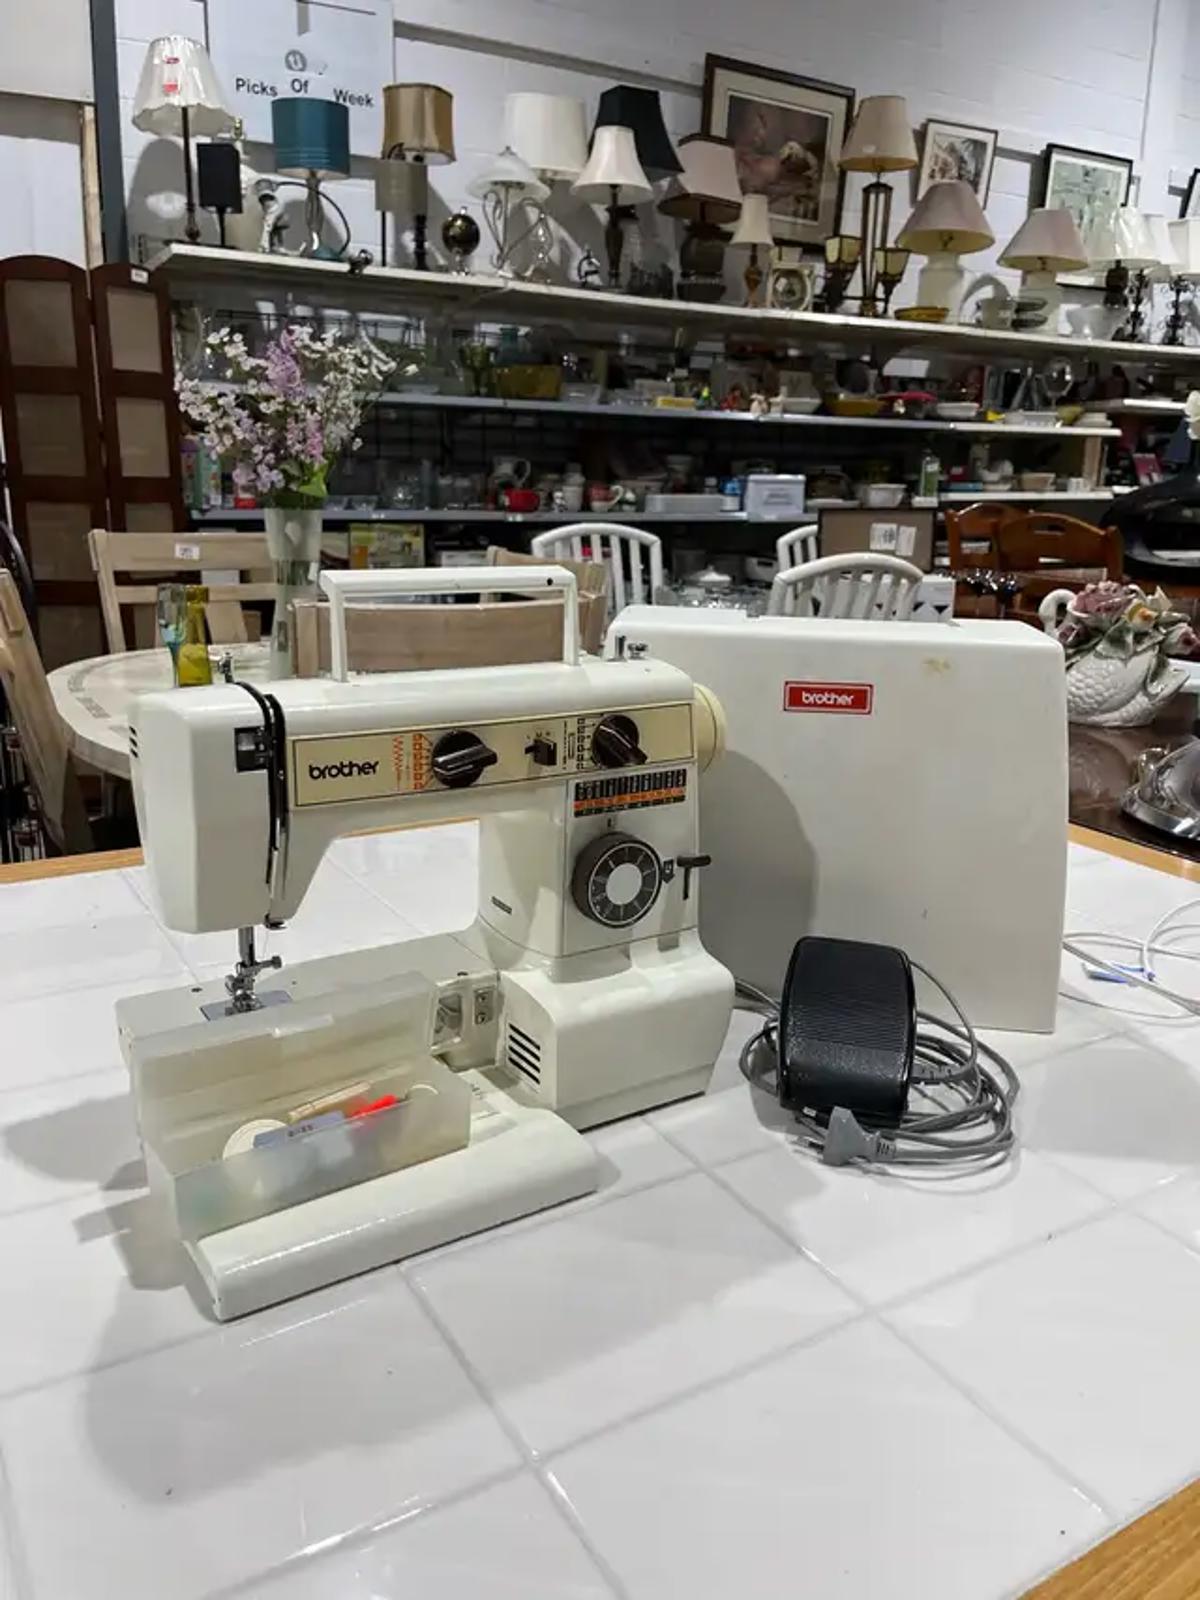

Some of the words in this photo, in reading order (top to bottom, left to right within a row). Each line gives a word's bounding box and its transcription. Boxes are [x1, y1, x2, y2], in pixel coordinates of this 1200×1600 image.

[235, 78, 278, 97] Picks
[290, 78, 309, 94] Of
[333, 88, 374, 107] Week
[802, 691, 854, 705] brother
[308, 760, 379, 780] brother
